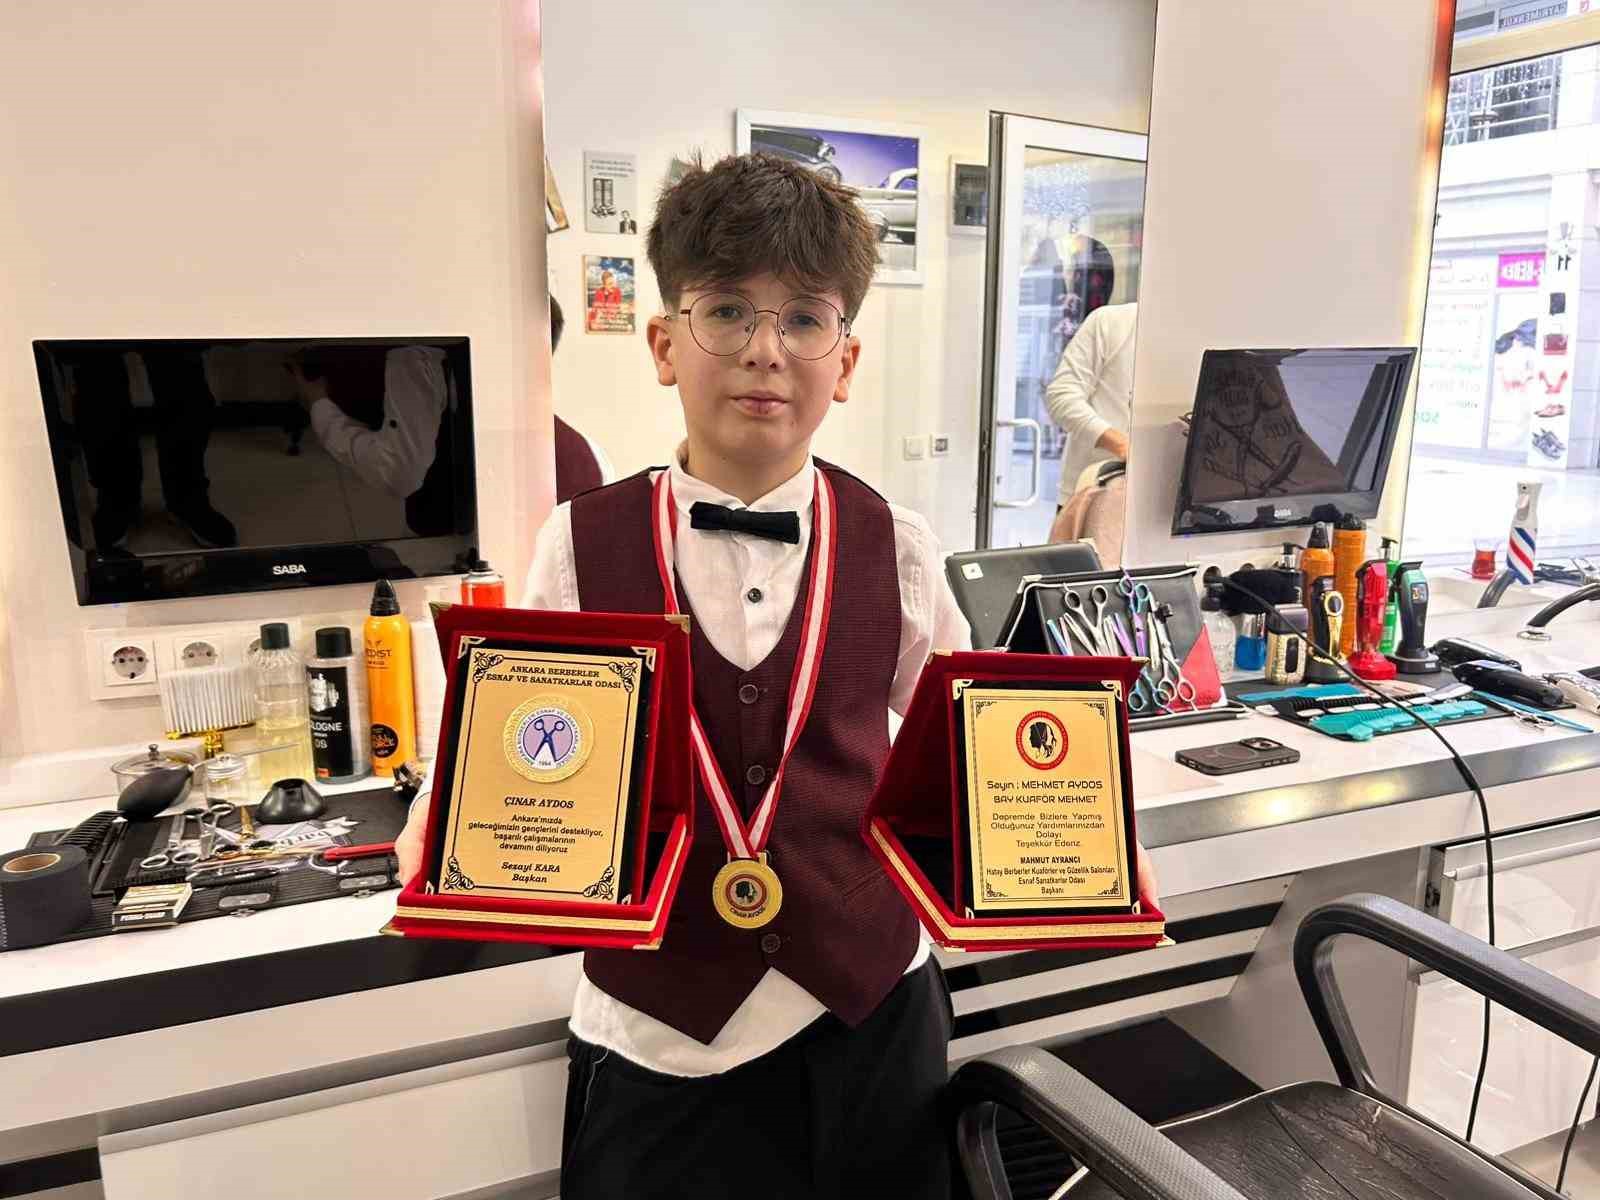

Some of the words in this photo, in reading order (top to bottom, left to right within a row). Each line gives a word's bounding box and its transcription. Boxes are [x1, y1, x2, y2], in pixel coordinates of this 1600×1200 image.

[272, 565, 306, 575] SABA
[510, 665, 546, 675] ANKARA
[548, 668, 600, 678] BERBERLER
[486, 673, 514, 682] ESNAF
[516, 675, 528, 683] VE
[530, 676, 593, 688] SANATKARLAR
[595, 680, 621, 689] ODASI
[1021, 780, 1065, 789] MEHMET
[1067, 780, 1103, 789] AYDOS
[504, 796, 536, 807] ÇINAR
[538, 798, 574, 809] AYDOS
[993, 795, 1014, 803] BAY
[1058, 795, 1097, 803] MEHMET
[511, 814, 562, 825] Ankara'mızda
[992, 813, 1035, 822] Depremde
[468, 821, 520, 832] geleceğimizin
[521, 825, 559, 834] gençlerini
[560, 827, 604, 838] destekliyor,
[990, 822, 1035, 831] Olduğunuz
[523, 835, 576, 845] çalışmalarının
[1036, 831, 1062, 839] Dolayı
[499, 842, 534, 851] devamını
[535, 845, 568, 854] diliyoruz
[1020, 856, 1049, 864] MAHMUT
[534, 863, 561, 873] KARA
[986, 869, 1003, 877] Hatay
[512, 873, 547, 884] Başkan
[1018, 877, 1035, 885] Esnaf
[1069, 876, 1086, 884] Odası
